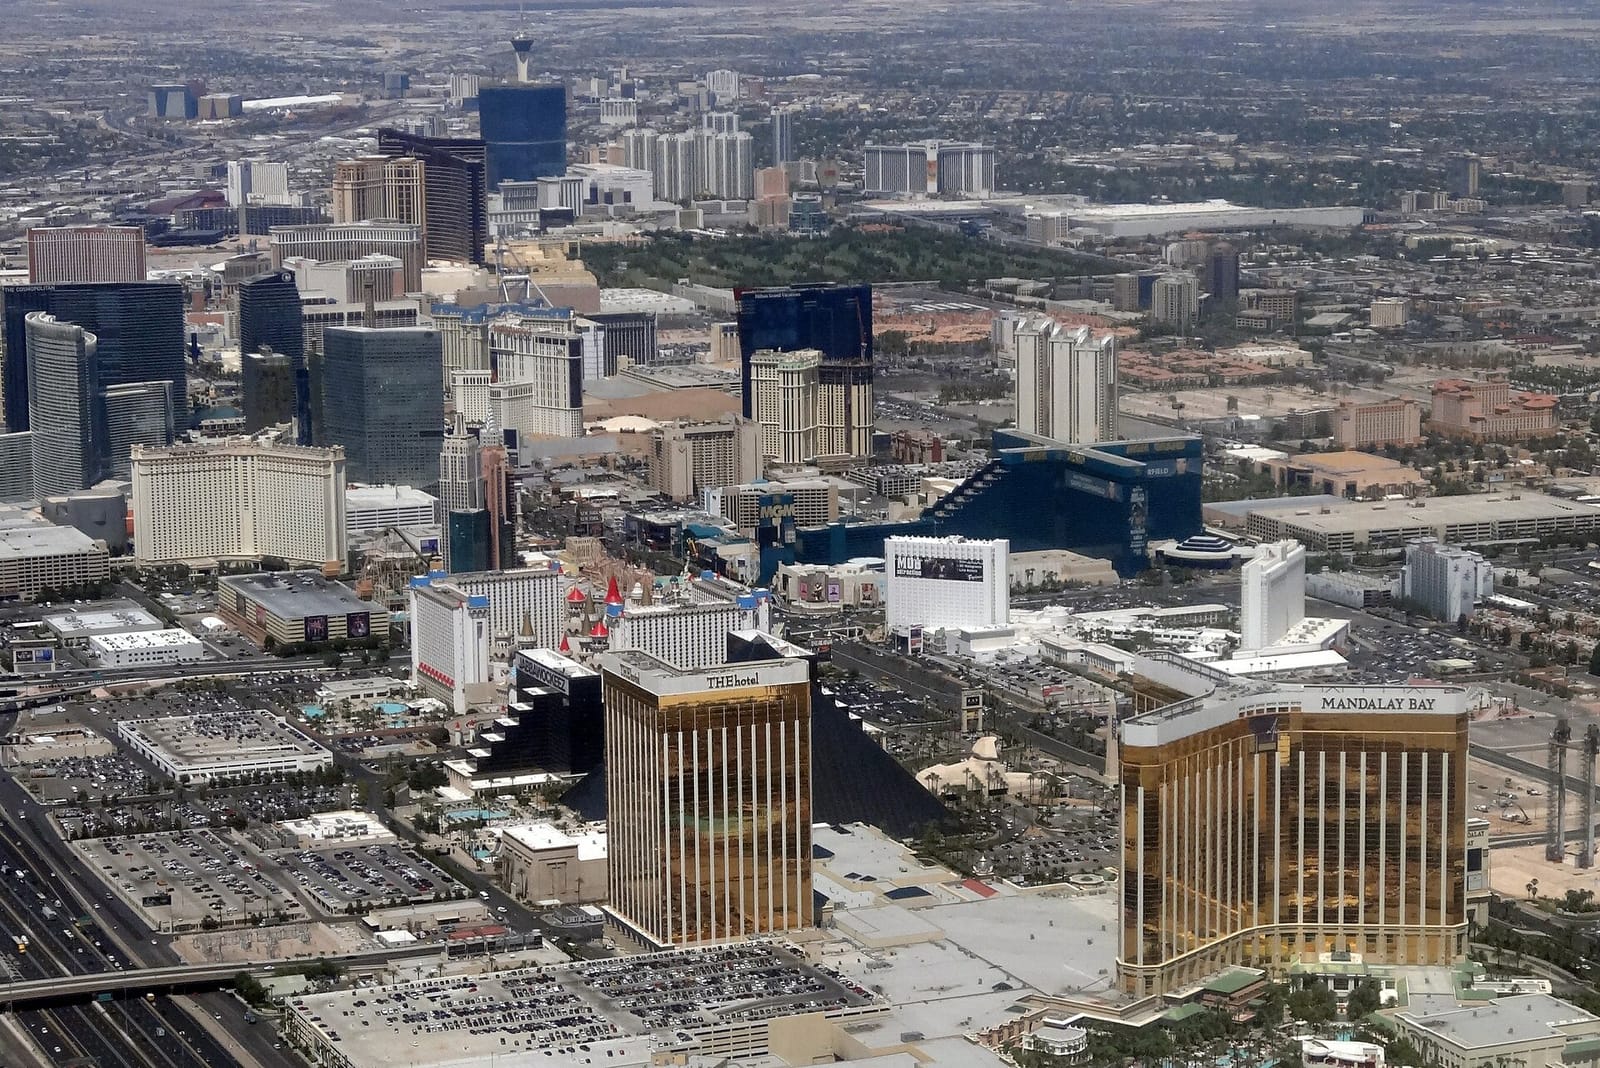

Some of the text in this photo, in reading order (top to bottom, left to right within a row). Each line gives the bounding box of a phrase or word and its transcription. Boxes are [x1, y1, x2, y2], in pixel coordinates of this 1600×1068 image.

[760, 504, 795, 518] MGM
[707, 672, 760, 689] THEhotel
[1321, 697, 1436, 710] MANDALAY BAY
